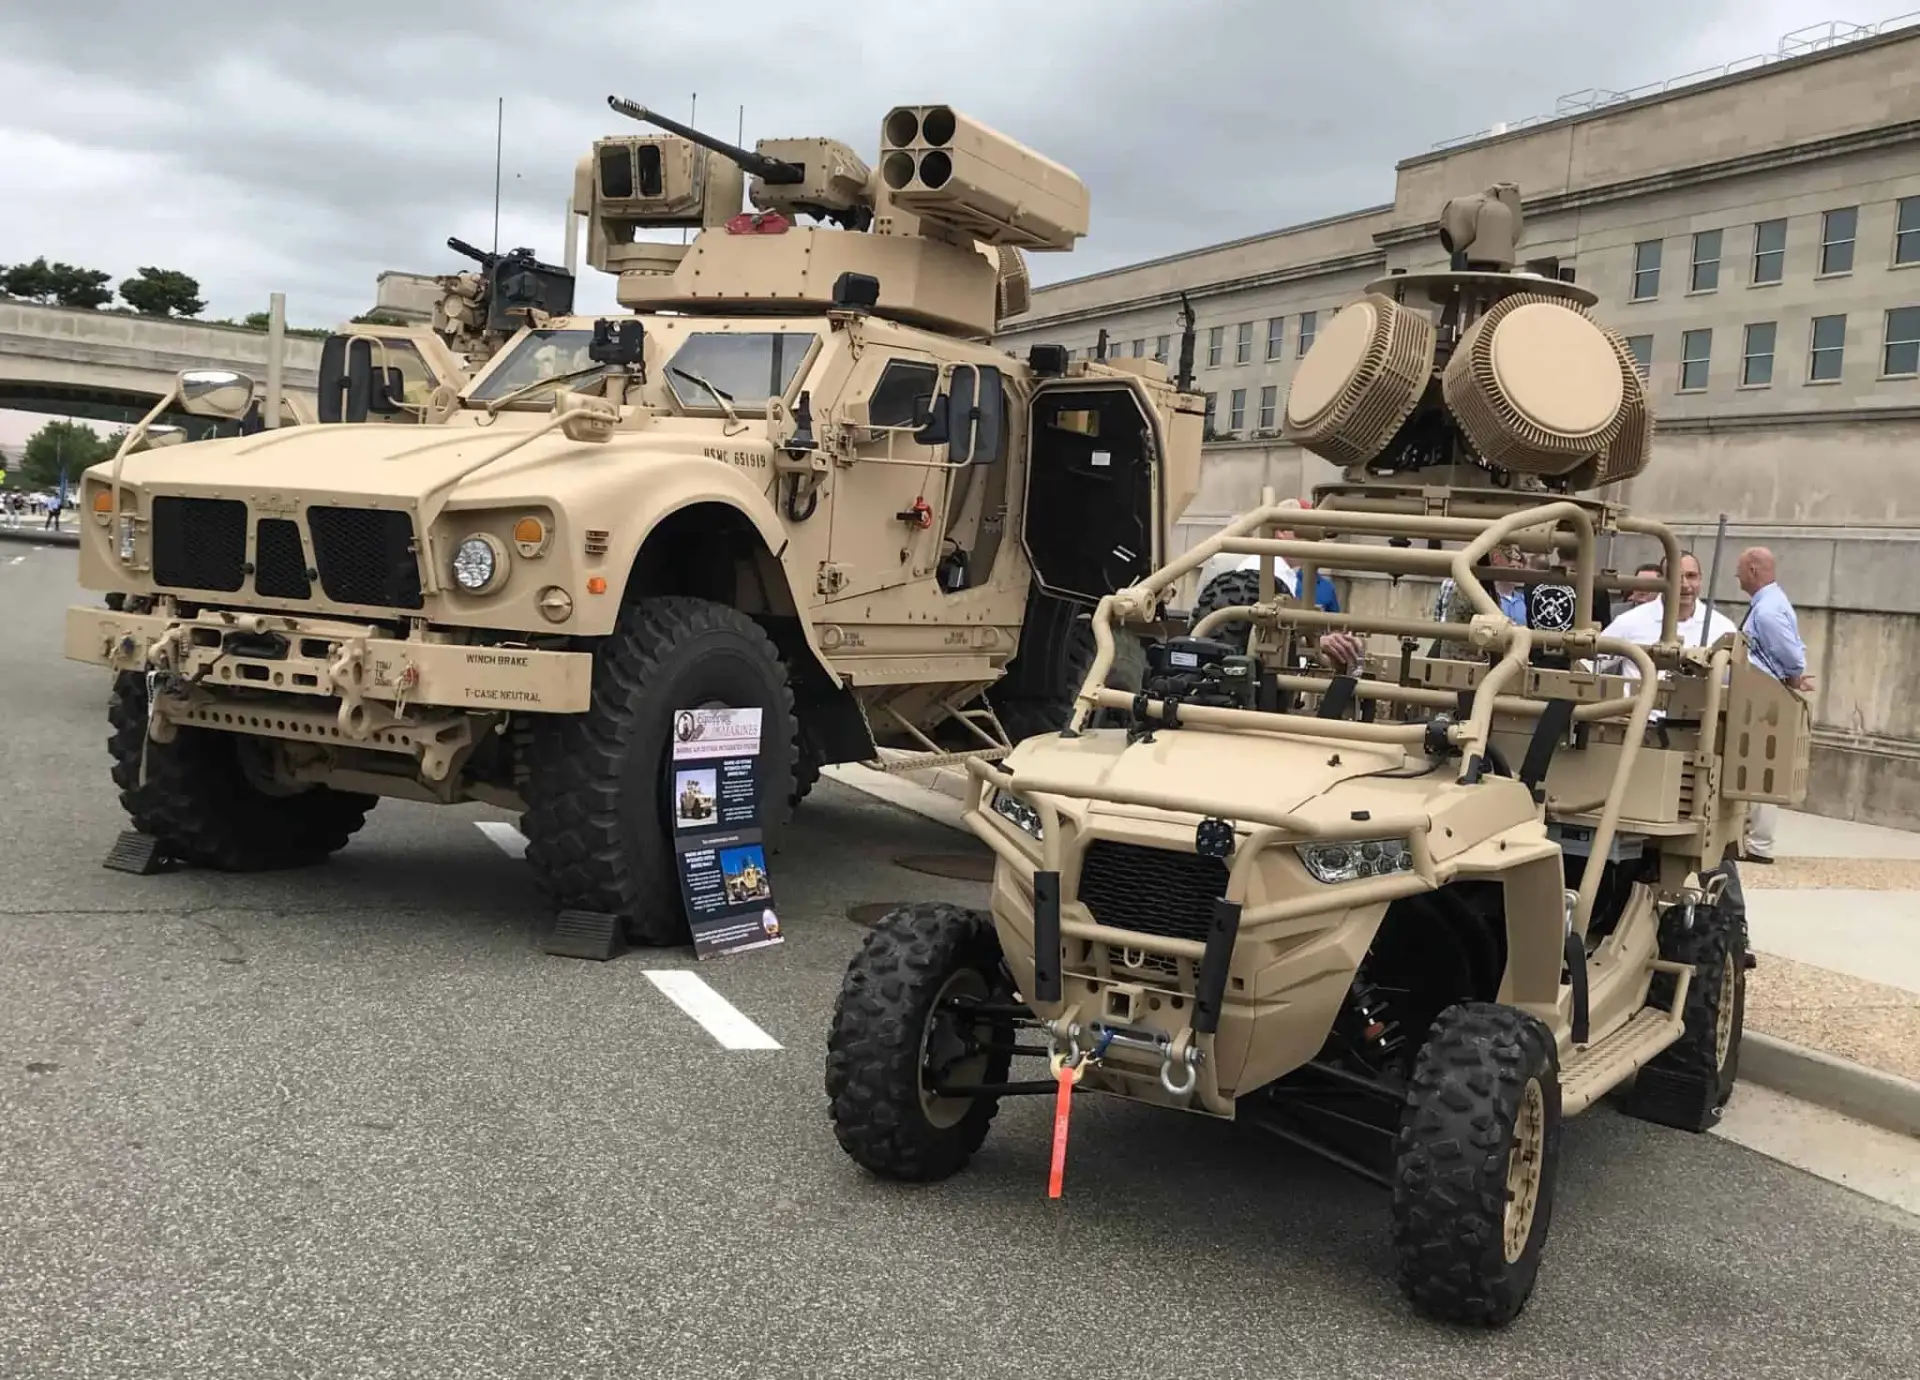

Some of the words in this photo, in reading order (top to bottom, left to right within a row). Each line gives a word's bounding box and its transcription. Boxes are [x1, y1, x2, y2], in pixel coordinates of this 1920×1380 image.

[703, 447, 729, 463] USMC
[465, 653, 496, 665] WINCH
[497, 655, 529, 667] BRAKE
[464, 687, 499, 700] T-CASE
[500, 690, 541, 702] NEUTRAL
